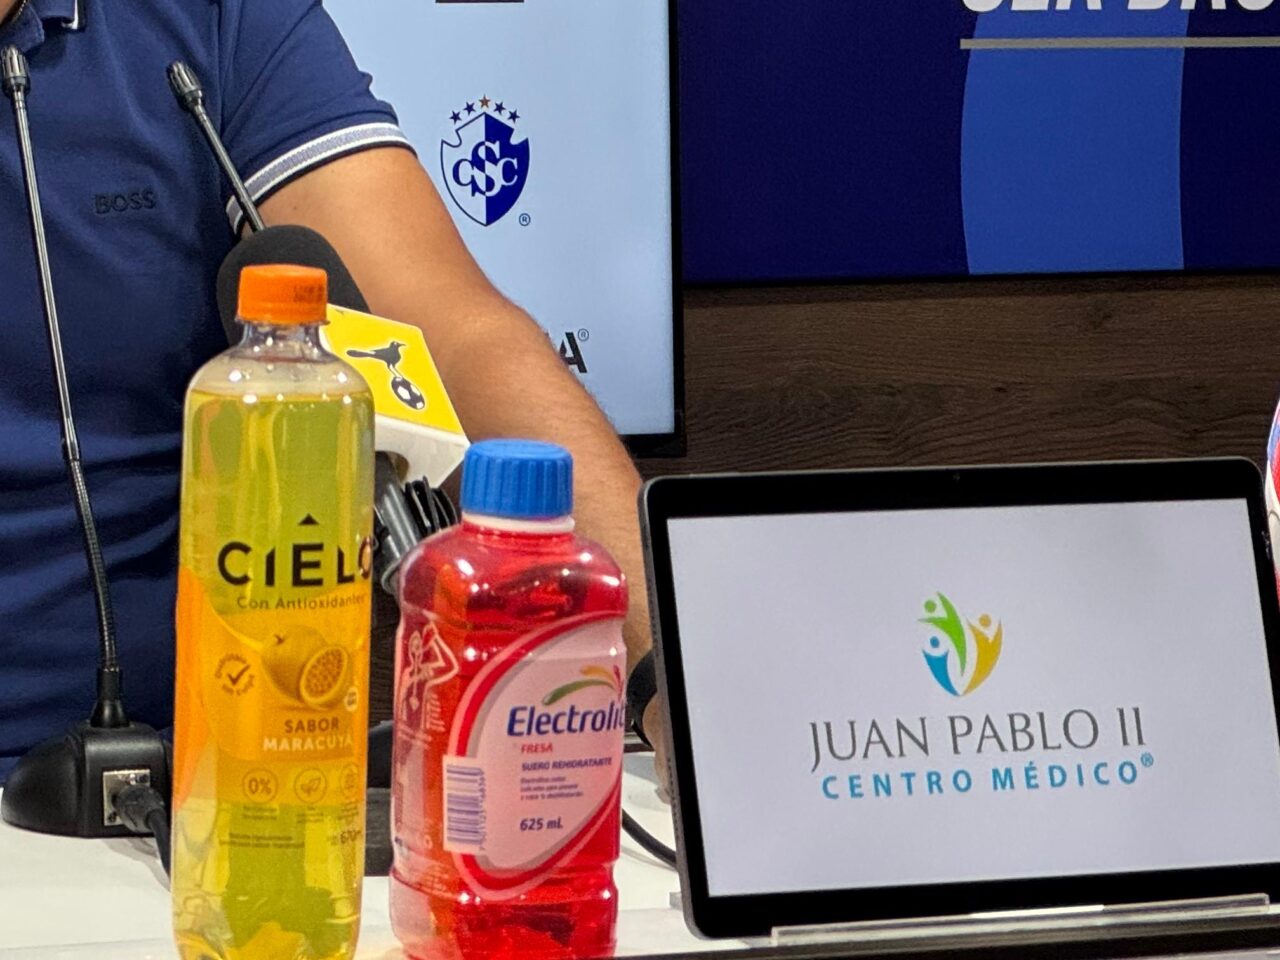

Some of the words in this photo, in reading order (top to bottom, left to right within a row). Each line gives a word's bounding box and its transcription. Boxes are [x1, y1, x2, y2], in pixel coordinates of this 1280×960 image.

[95, 189, 157, 215] BOSS
[237, 596, 269, 610] Con
[284, 716, 339, 734] SABOR
[521, 743, 553, 754] FRESA
[809, 717, 929, 773] JUAN
[948, 708, 1099, 755] PABLO
[1117, 706, 1146, 746] II
[822, 769, 972, 800] CENTRO
[520, 818, 543, 831] 625
